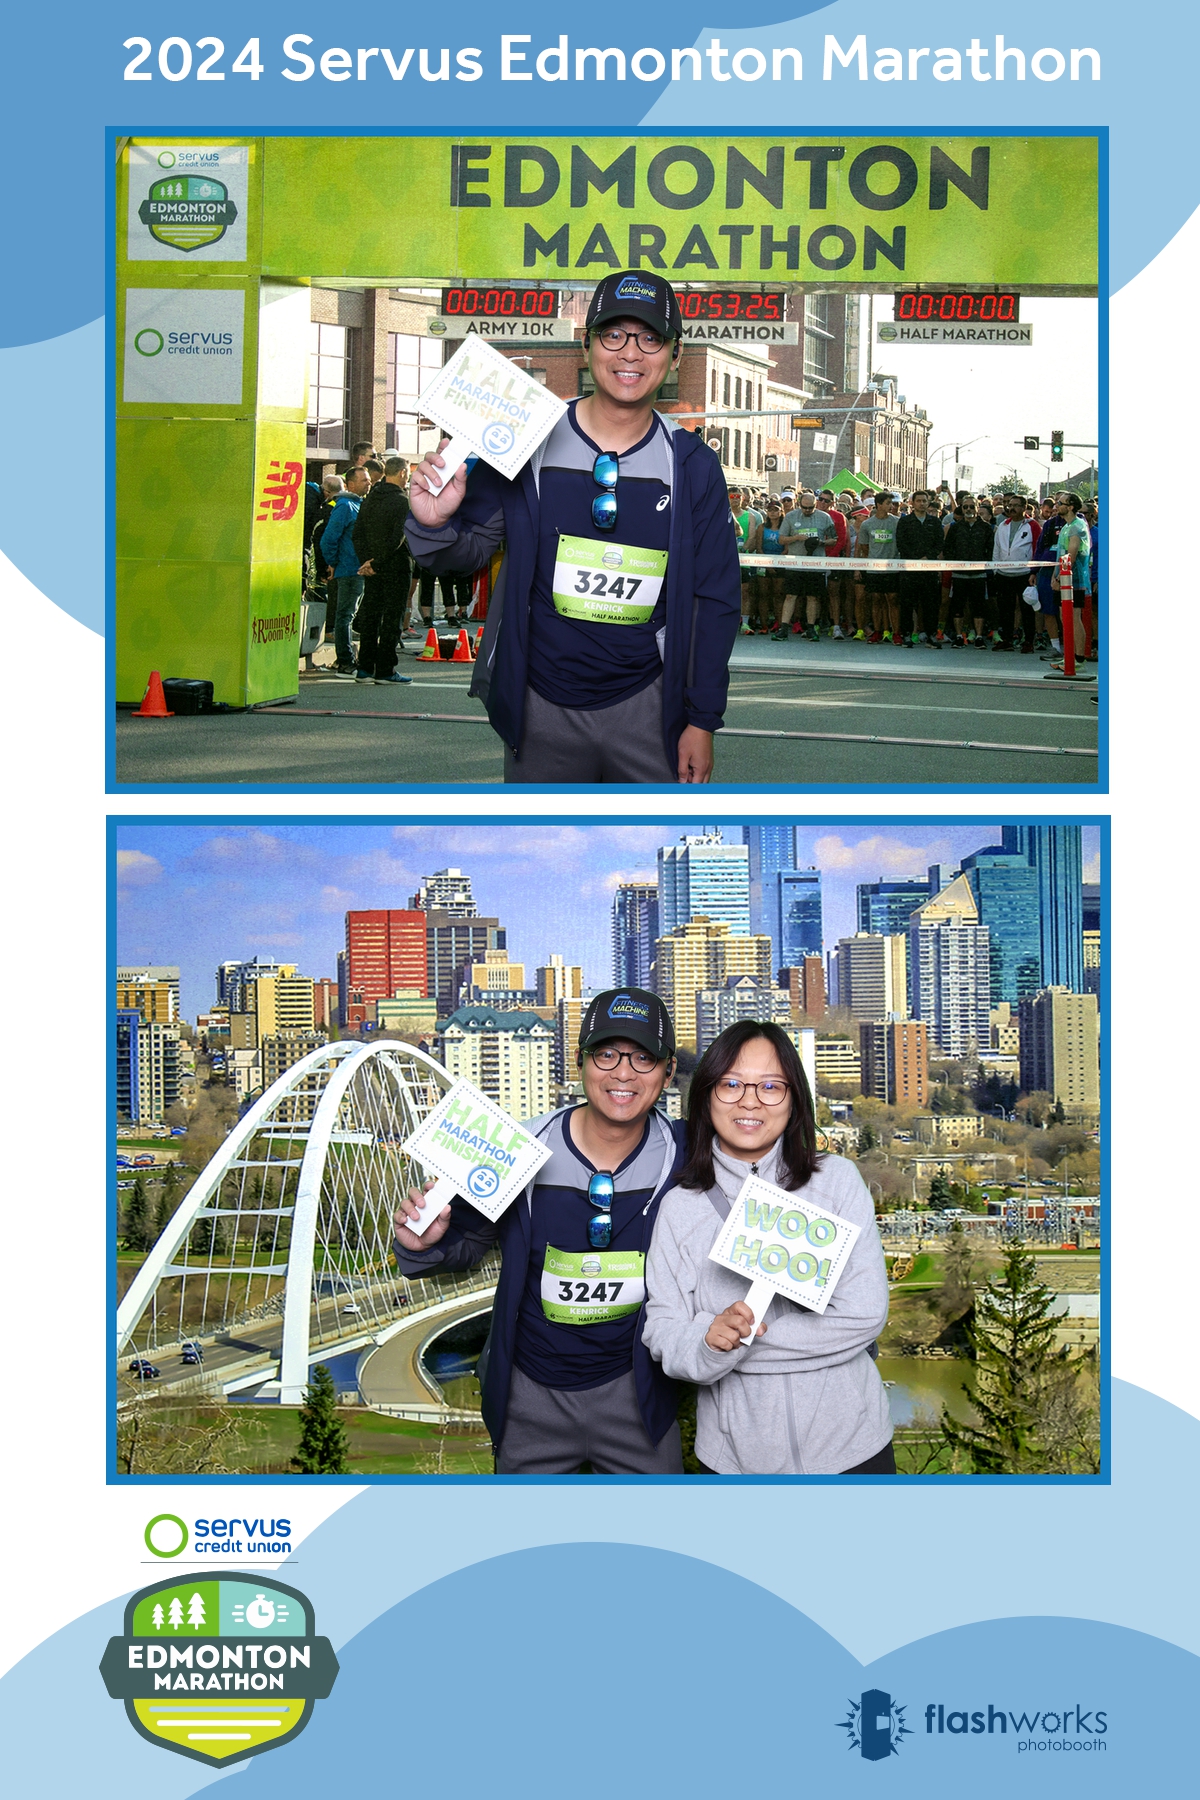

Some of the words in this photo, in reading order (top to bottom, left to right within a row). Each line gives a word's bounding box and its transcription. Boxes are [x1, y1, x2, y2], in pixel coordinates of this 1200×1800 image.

[178, 151, 220, 162] servus
[449, 144, 990, 211] EDMONTON
[149, 202, 227, 214] EDMONTON
[160, 213, 215, 222] MARATHON
[523, 222, 906, 270] MARATHON
[619, 287, 657, 298] MACHINE
[622, 281, 657, 293] FITNESS
[465, 321, 518, 335] ARMY
[521, 322, 554, 336] 10K
[681, 325, 785, 340] MARATHON
[900, 328, 939, 340] HALF
[943, 328, 1030, 341] MARATHON
[168, 331, 233, 344] servus
[168, 344, 200, 355] credit
[203, 346, 233, 355] union
[456, 355, 542, 407] HALF
[450, 376, 531, 422] MARATHON
[443, 387, 527, 436] FINISHER!
[574, 569, 643, 600] 3247
[583, 601, 624, 613] KENRICK
[591, 612, 606, 620] HALF
[607, 614, 640, 622] MARATHON
[612, 1005, 650, 1017] MACHINE
[615, 999, 650, 1011] FITNESS
[444, 1098, 529, 1153] HALF
[439, 1118, 517, 1167] MARATHON
[431, 1129, 511, 1180] FINISHER!
[744, 1197, 837, 1248] WOO
[729, 1234, 832, 1288] HOO!
[558, 1280, 624, 1302] 3247
[569, 1307, 609, 1315] KENRICK
[594, 1311, 628, 1320] MARATHON
